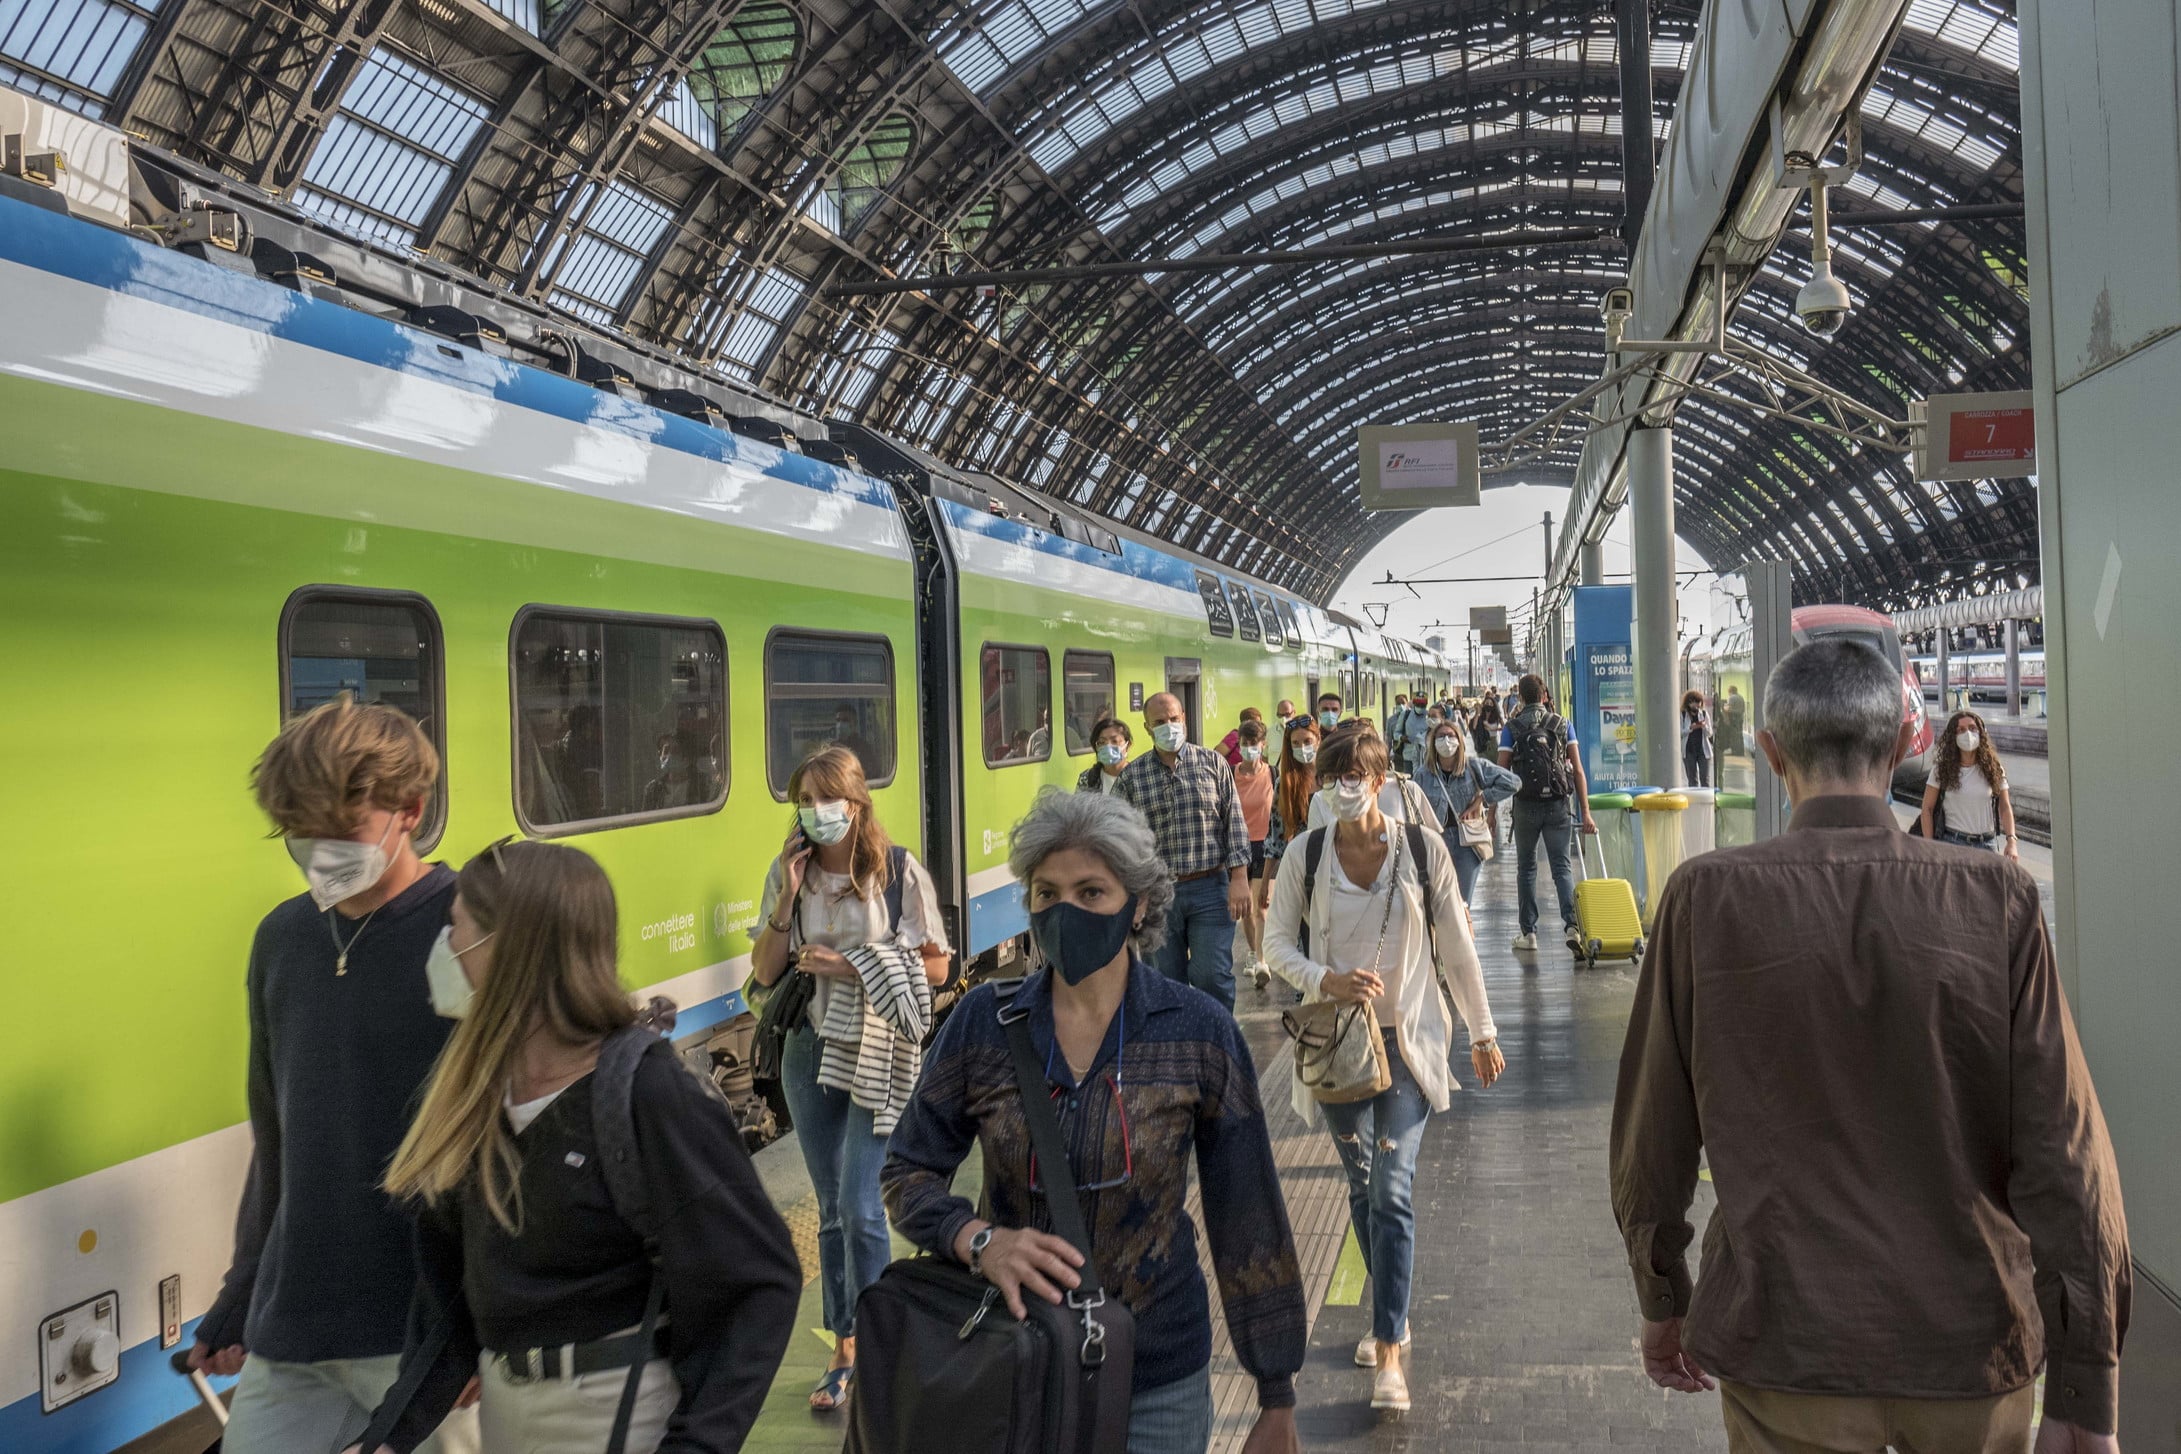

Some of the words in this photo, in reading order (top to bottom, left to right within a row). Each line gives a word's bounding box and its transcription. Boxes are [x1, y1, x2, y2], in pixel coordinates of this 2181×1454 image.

[1985, 424, 1996, 443] 7
[1590, 655, 1628, 664] QUANDO
[1595, 666, 1606, 675] LO
[1607, 666, 1633, 675] SPAZZ
[1622, 772, 1638, 780] PRO
[641, 912, 695, 941] connettere
